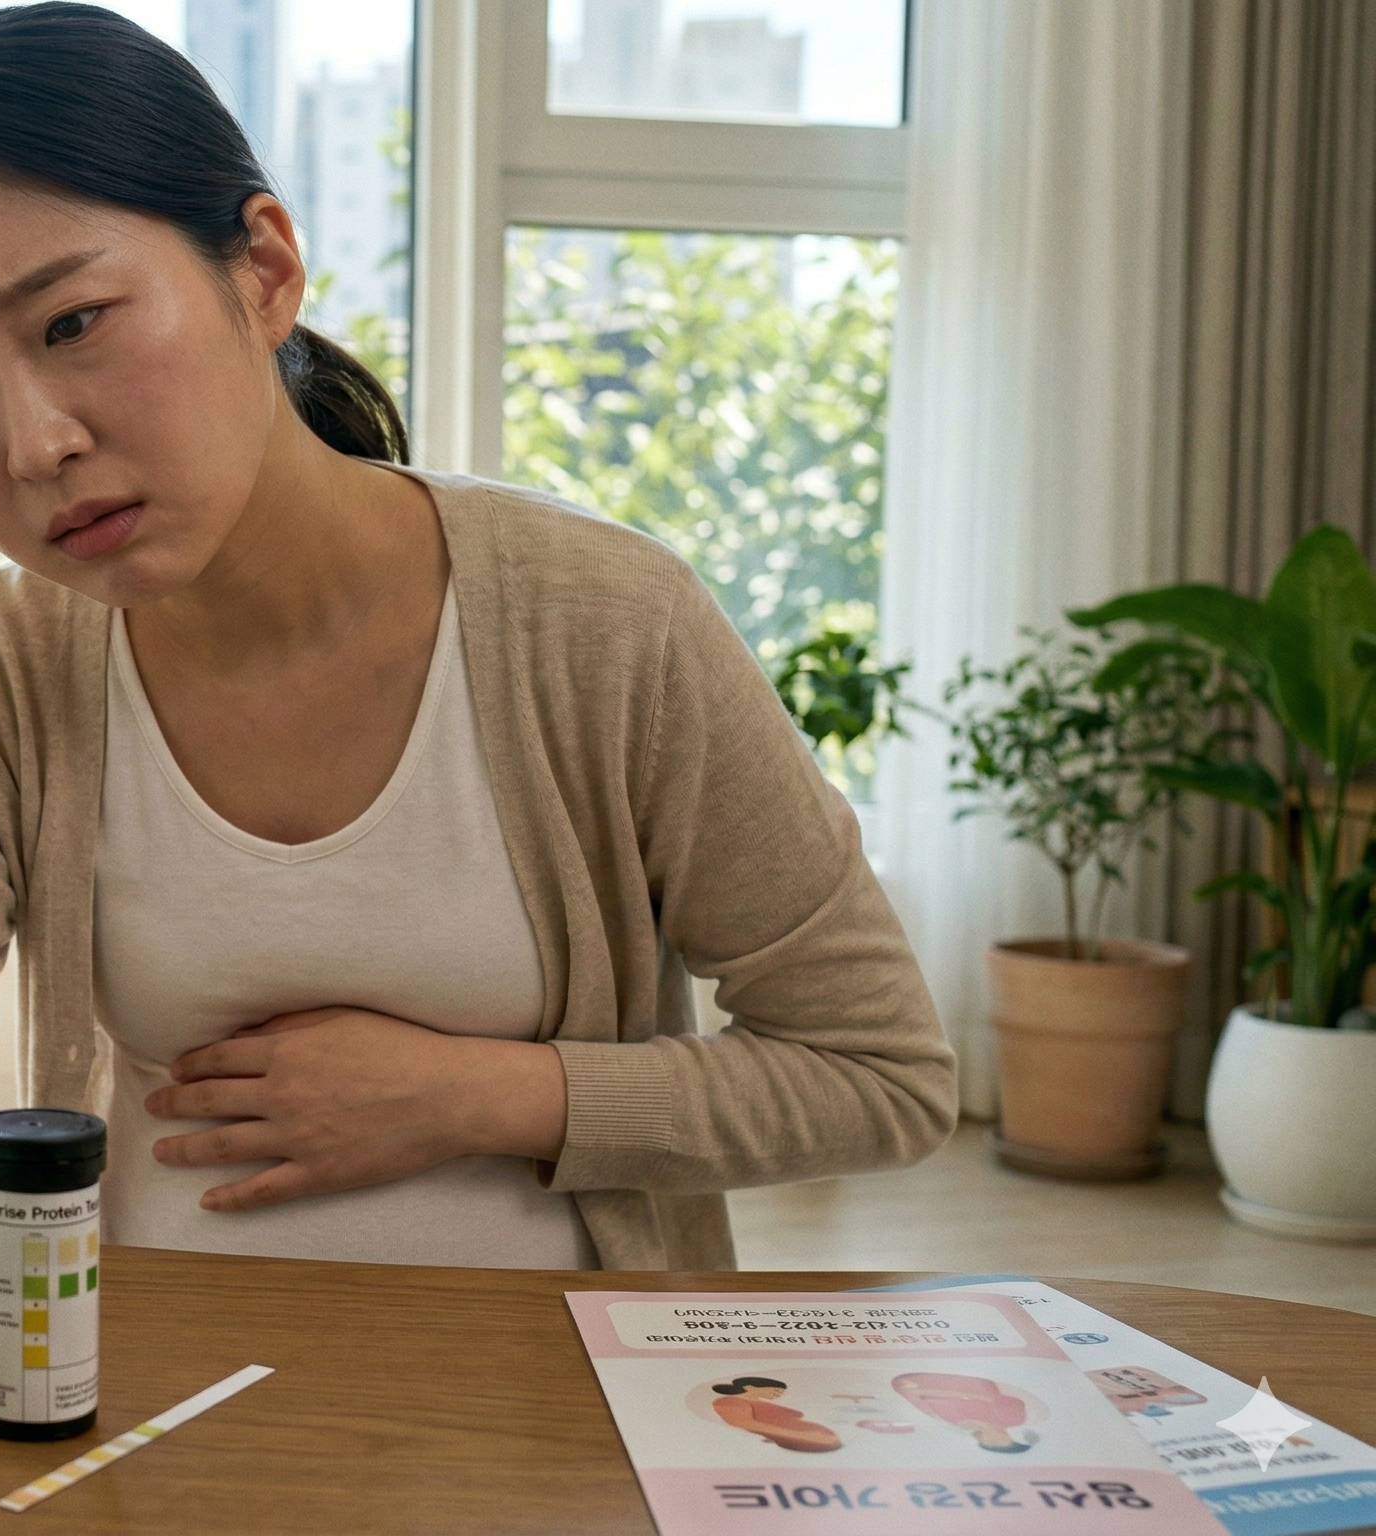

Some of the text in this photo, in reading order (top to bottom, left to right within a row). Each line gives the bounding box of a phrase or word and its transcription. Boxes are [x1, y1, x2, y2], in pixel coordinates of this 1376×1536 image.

[31, 1202, 83, 1220] Protein
[713, 1481, 1153, 1510] 임신 건강 가이드
